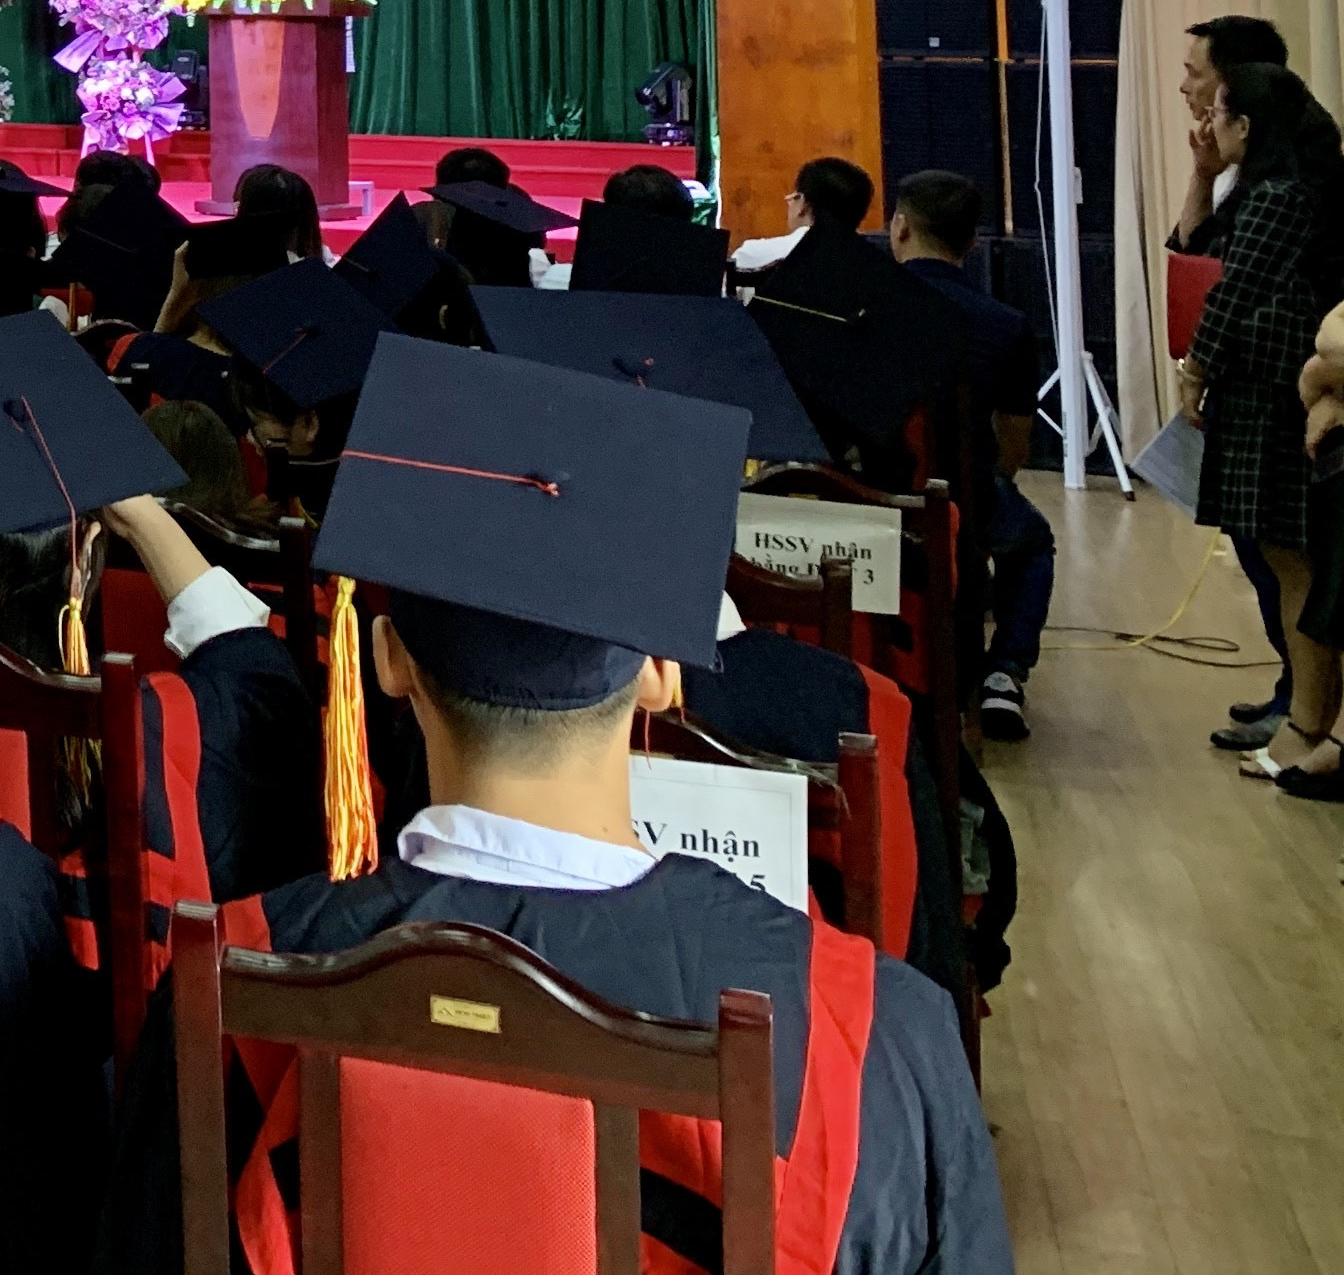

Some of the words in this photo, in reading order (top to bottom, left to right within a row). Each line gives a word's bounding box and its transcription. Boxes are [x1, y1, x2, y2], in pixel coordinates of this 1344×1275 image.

[755, 532, 813, 553] HSSV
[863, 569, 874, 585] 3
[681, 828, 760, 862] nhận
